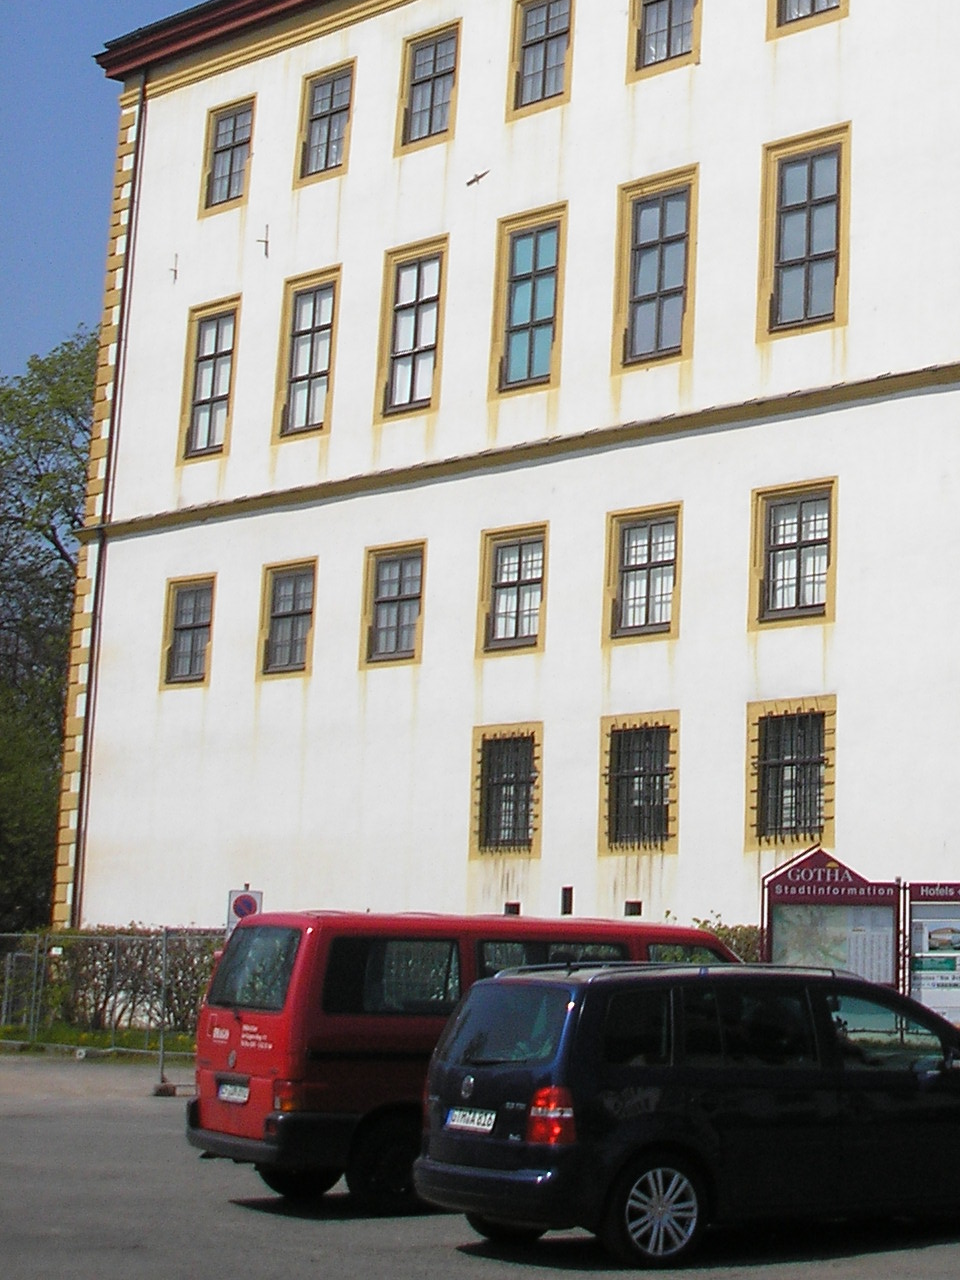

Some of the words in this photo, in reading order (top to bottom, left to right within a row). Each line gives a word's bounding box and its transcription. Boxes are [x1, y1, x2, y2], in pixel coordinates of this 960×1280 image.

[787, 867, 853, 882] GOTHA
[775, 884, 894, 896] Stadtinformation
[920, 886, 954, 897] Hotels
